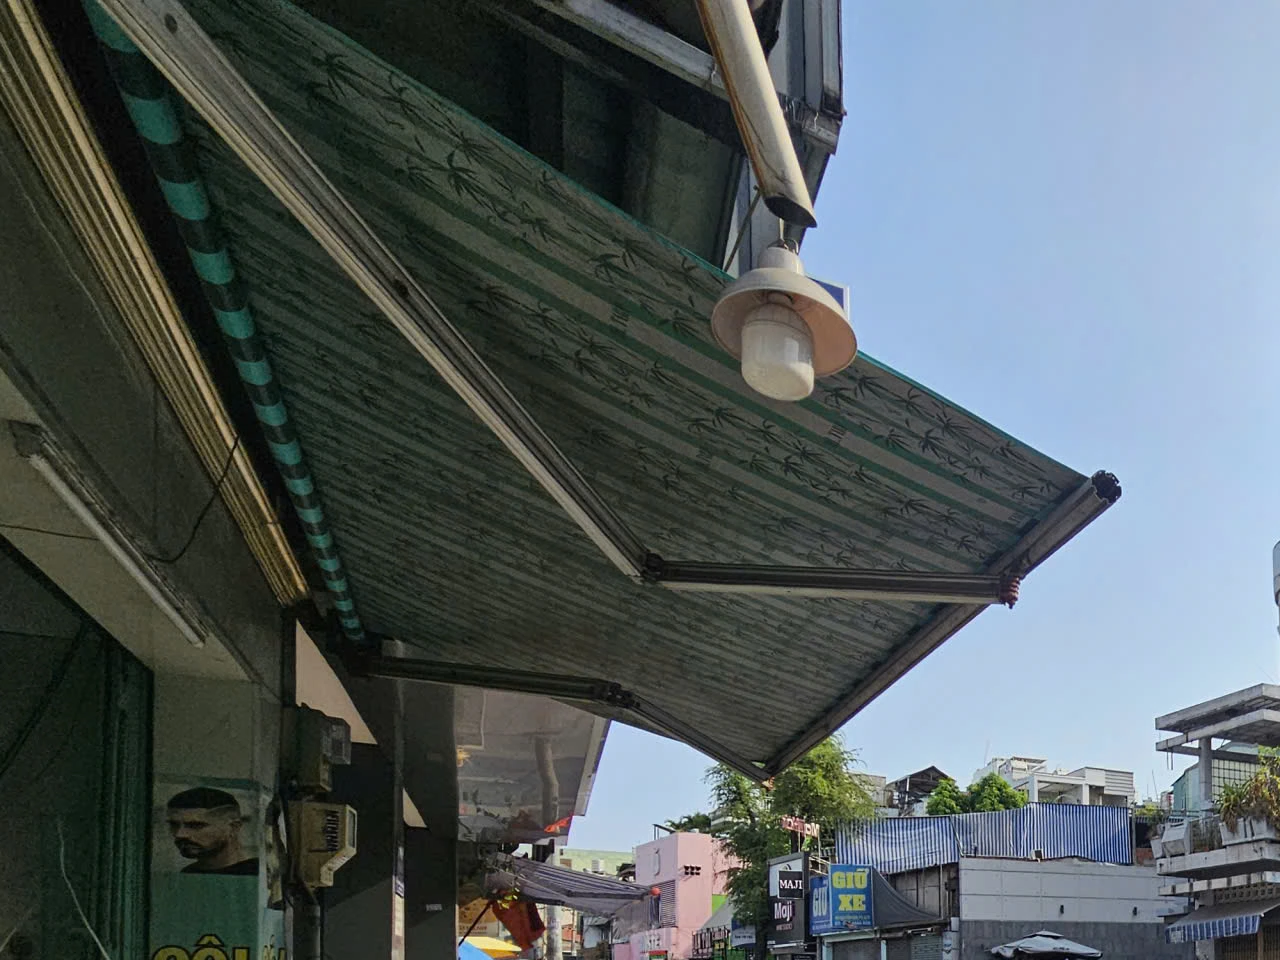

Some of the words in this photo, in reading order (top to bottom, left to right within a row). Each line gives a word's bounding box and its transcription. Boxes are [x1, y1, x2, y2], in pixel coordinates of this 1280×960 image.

[779, 879, 803, 889] MAJI
[832, 868, 870, 889] GIỮ
[774, 901, 792, 922] Maji
[838, 894, 866, 911] XE
